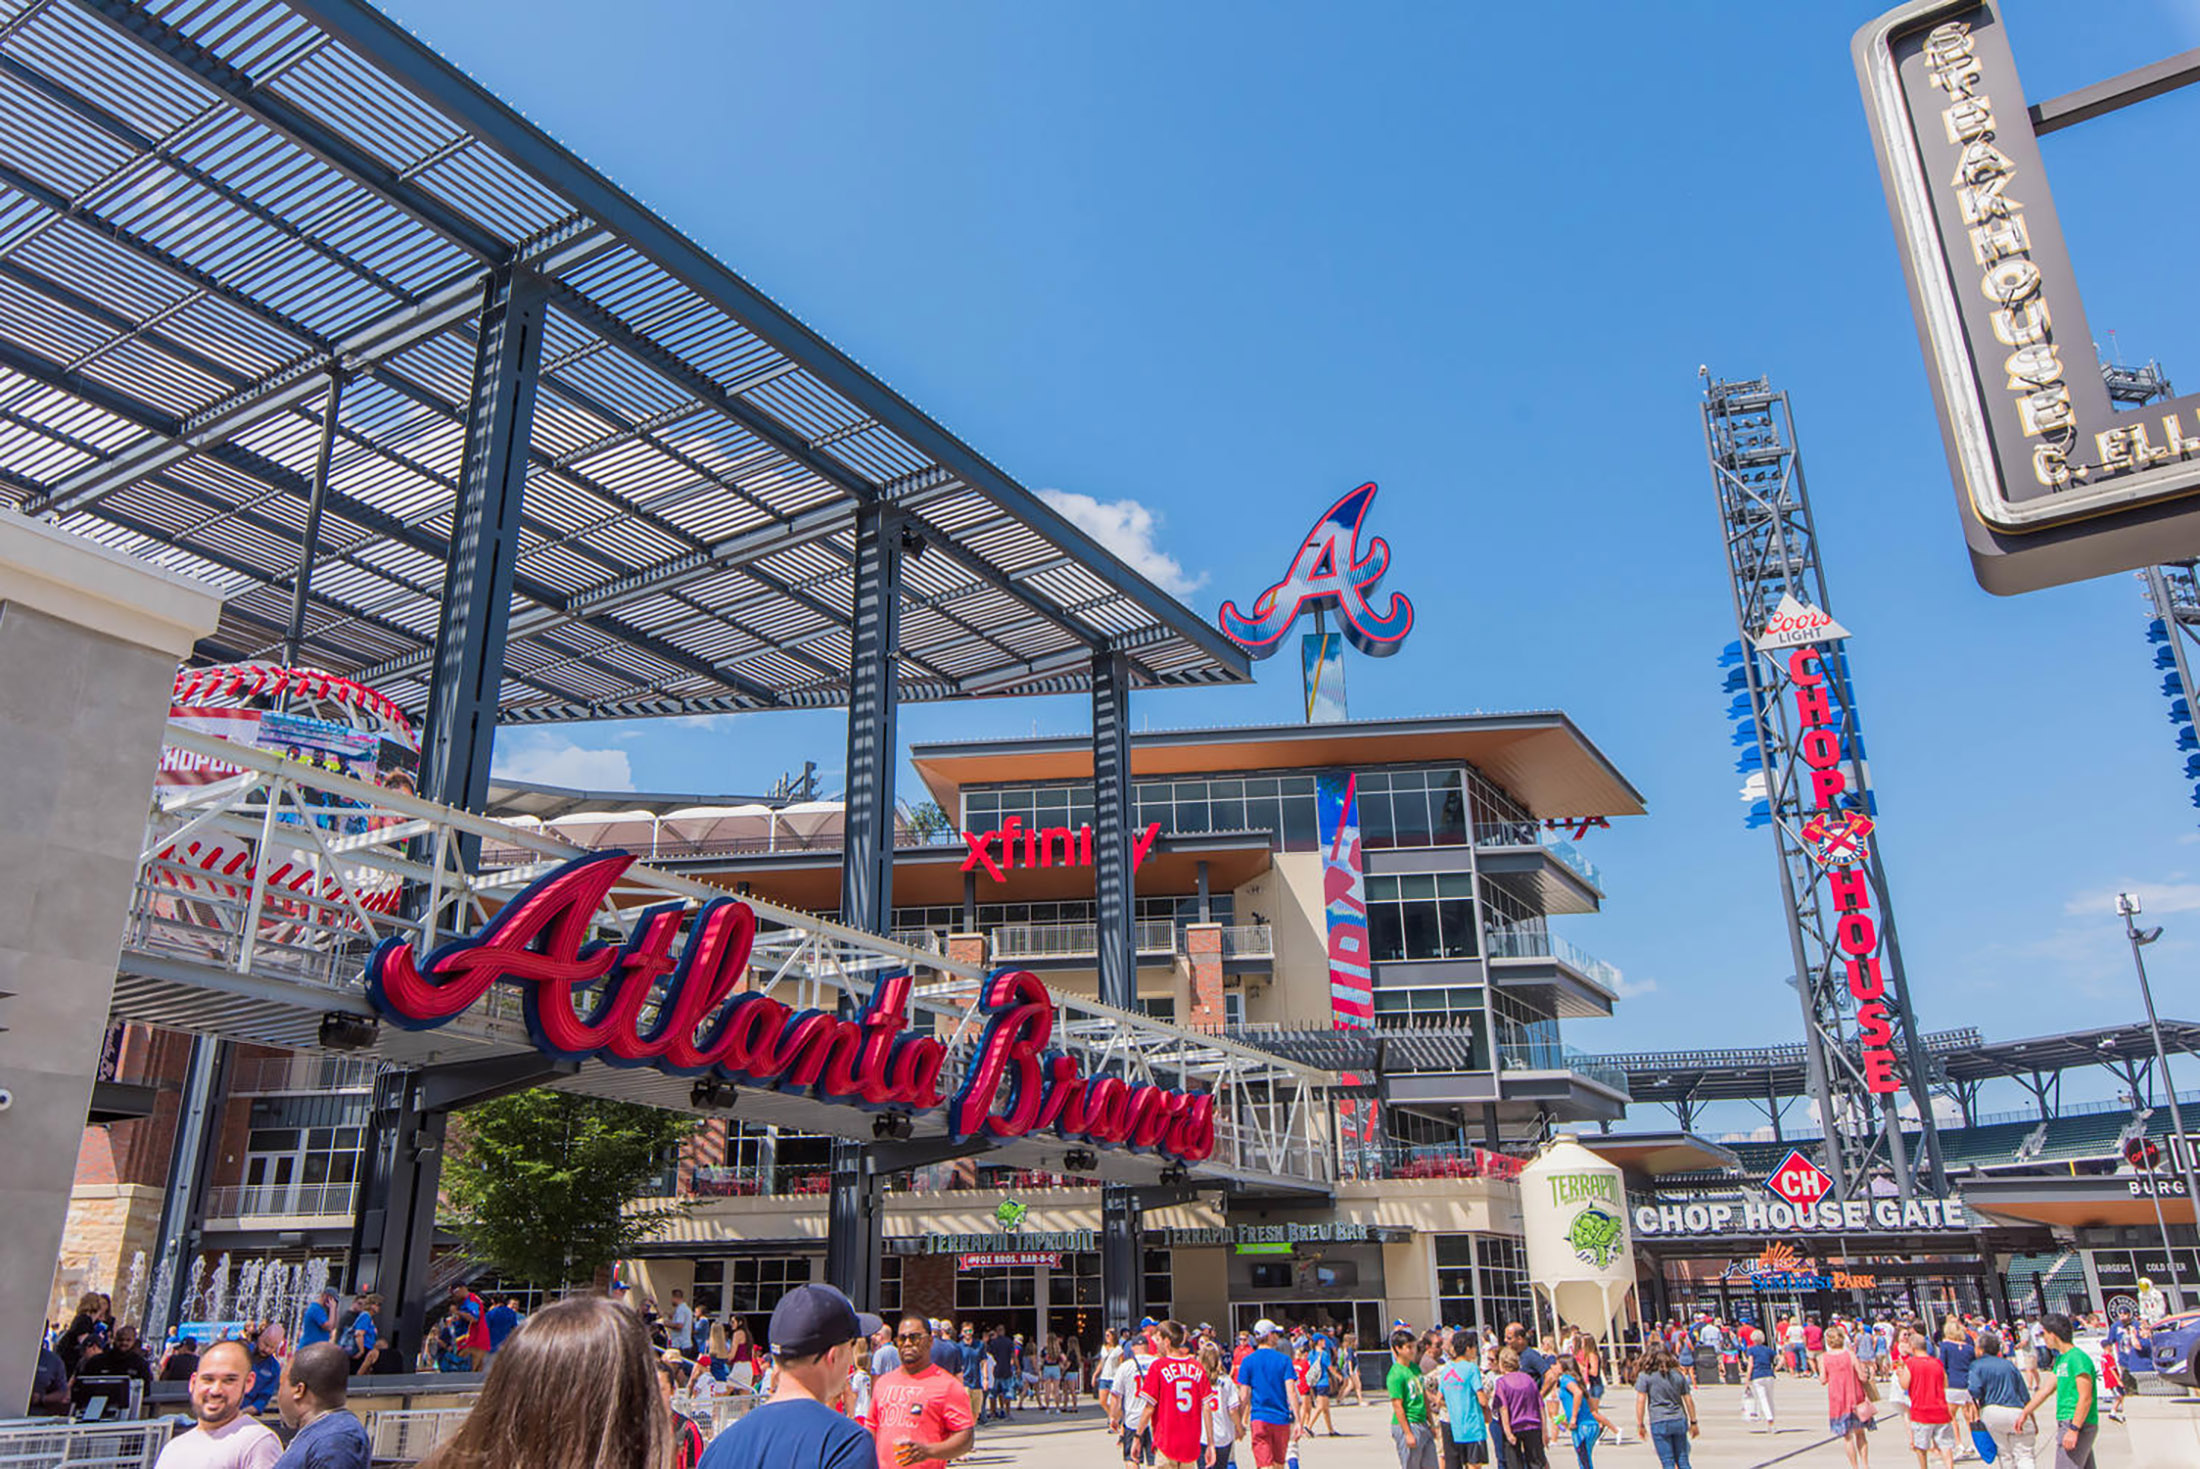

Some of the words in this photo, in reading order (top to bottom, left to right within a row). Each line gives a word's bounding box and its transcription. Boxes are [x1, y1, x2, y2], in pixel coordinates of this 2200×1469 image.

[1922, 20, 2078, 438] STEAKHOUSE
[1219, 481, 1414, 658] A
[1765, 610, 1832, 635] Coors
[1778, 626, 1823, 644] LIGHT
[1788, 647, 1846, 809] CHOP
[960, 815, 1162, 883] xfiniy
[1829, 869, 1901, 1093] HOUSE
[364, 848, 949, 1113] Atlanta
[948, 964, 1214, 1168] Braves
[1547, 1173, 1621, 1208] TERRAPIN
[1780, 1169, 1821, 1197] CH
[1635, 1204, 1731, 1233] CHOP
[1744, 1201, 1868, 1231] HOUSE
[1875, 1198, 1966, 1228] GATE
[926, 1232, 1008, 1254] TERRAPIN
[1016, 1228, 1096, 1252] TAPROOM
[1162, 1226, 1234, 1246] TERRAPIN
[1236, 1222, 1285, 1244] FRESH
[1286, 1221, 1332, 1243] BREW
[1334, 1222, 1368, 1241] BAR
[1161, 1362, 1203, 1384] BENCH
[1176, 1380, 1193, 1412] 5
